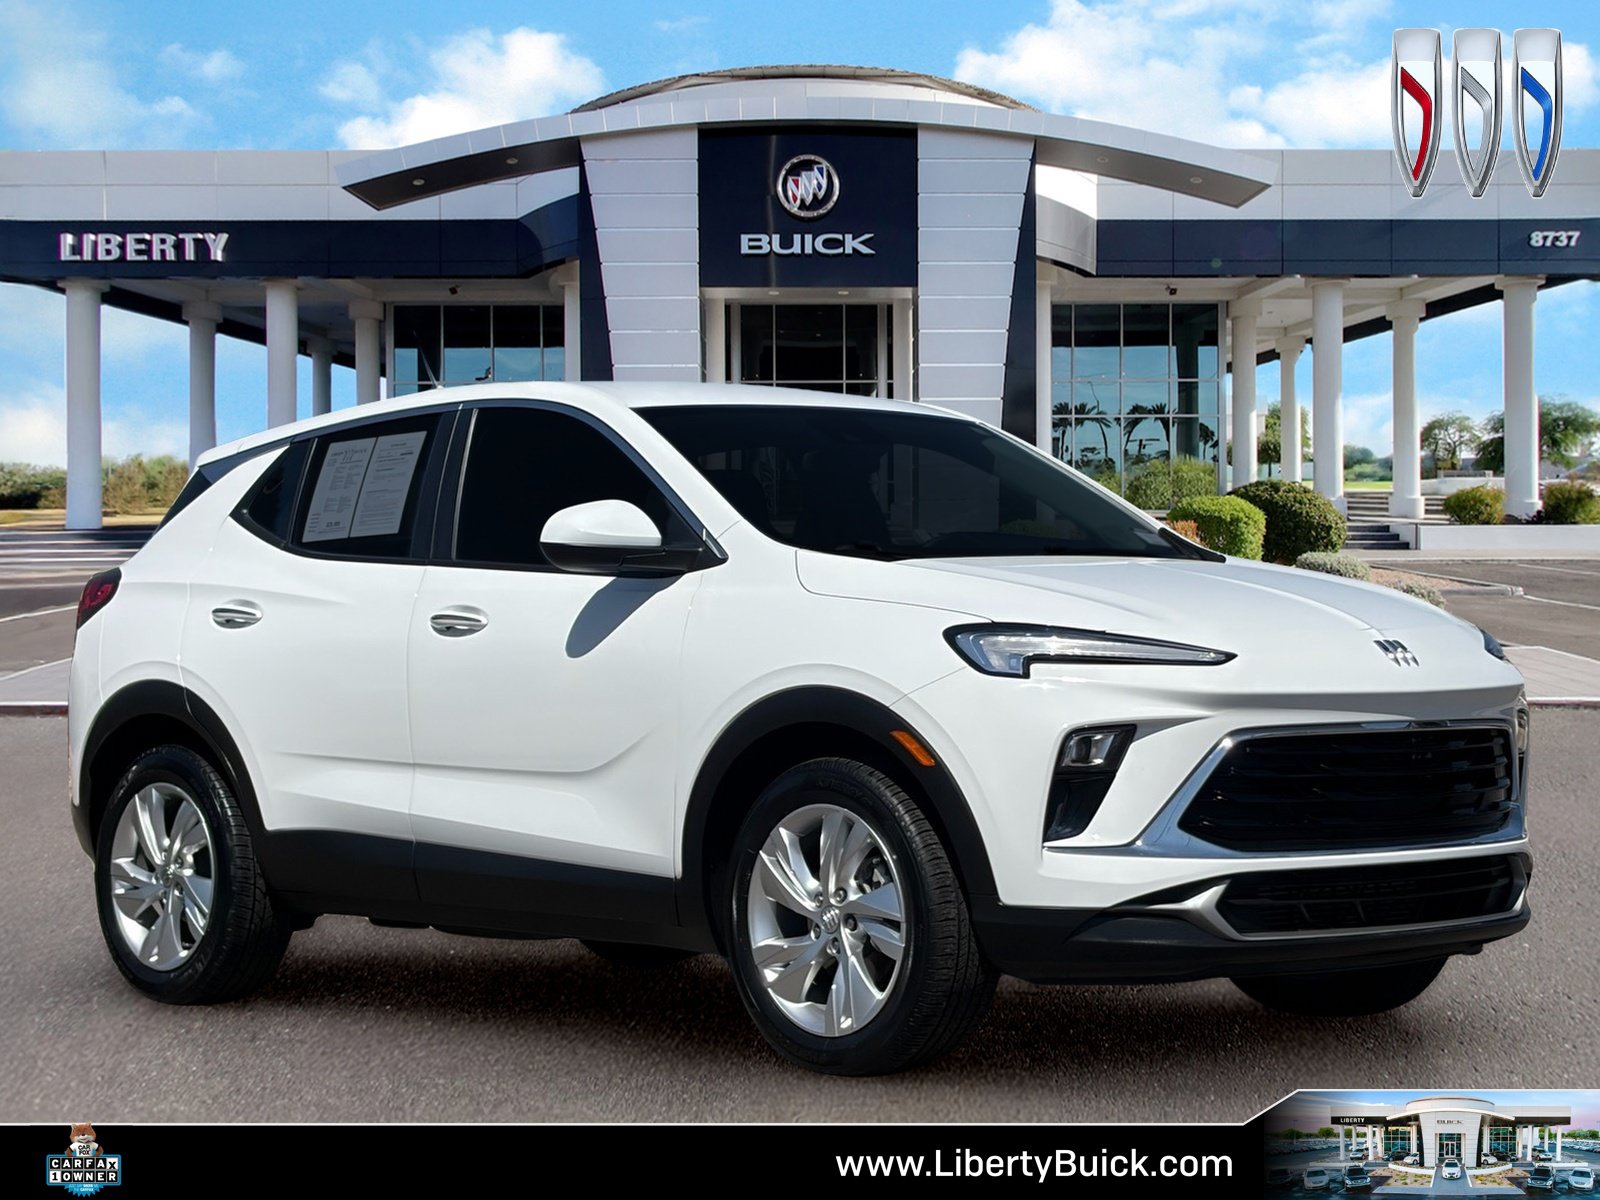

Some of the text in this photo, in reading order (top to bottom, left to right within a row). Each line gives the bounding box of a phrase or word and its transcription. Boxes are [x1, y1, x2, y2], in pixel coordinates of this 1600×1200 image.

[59, 232, 229, 262] LIBERTY
[740, 233, 876, 255] BUICK
[1529, 230, 1581, 247] 8737
